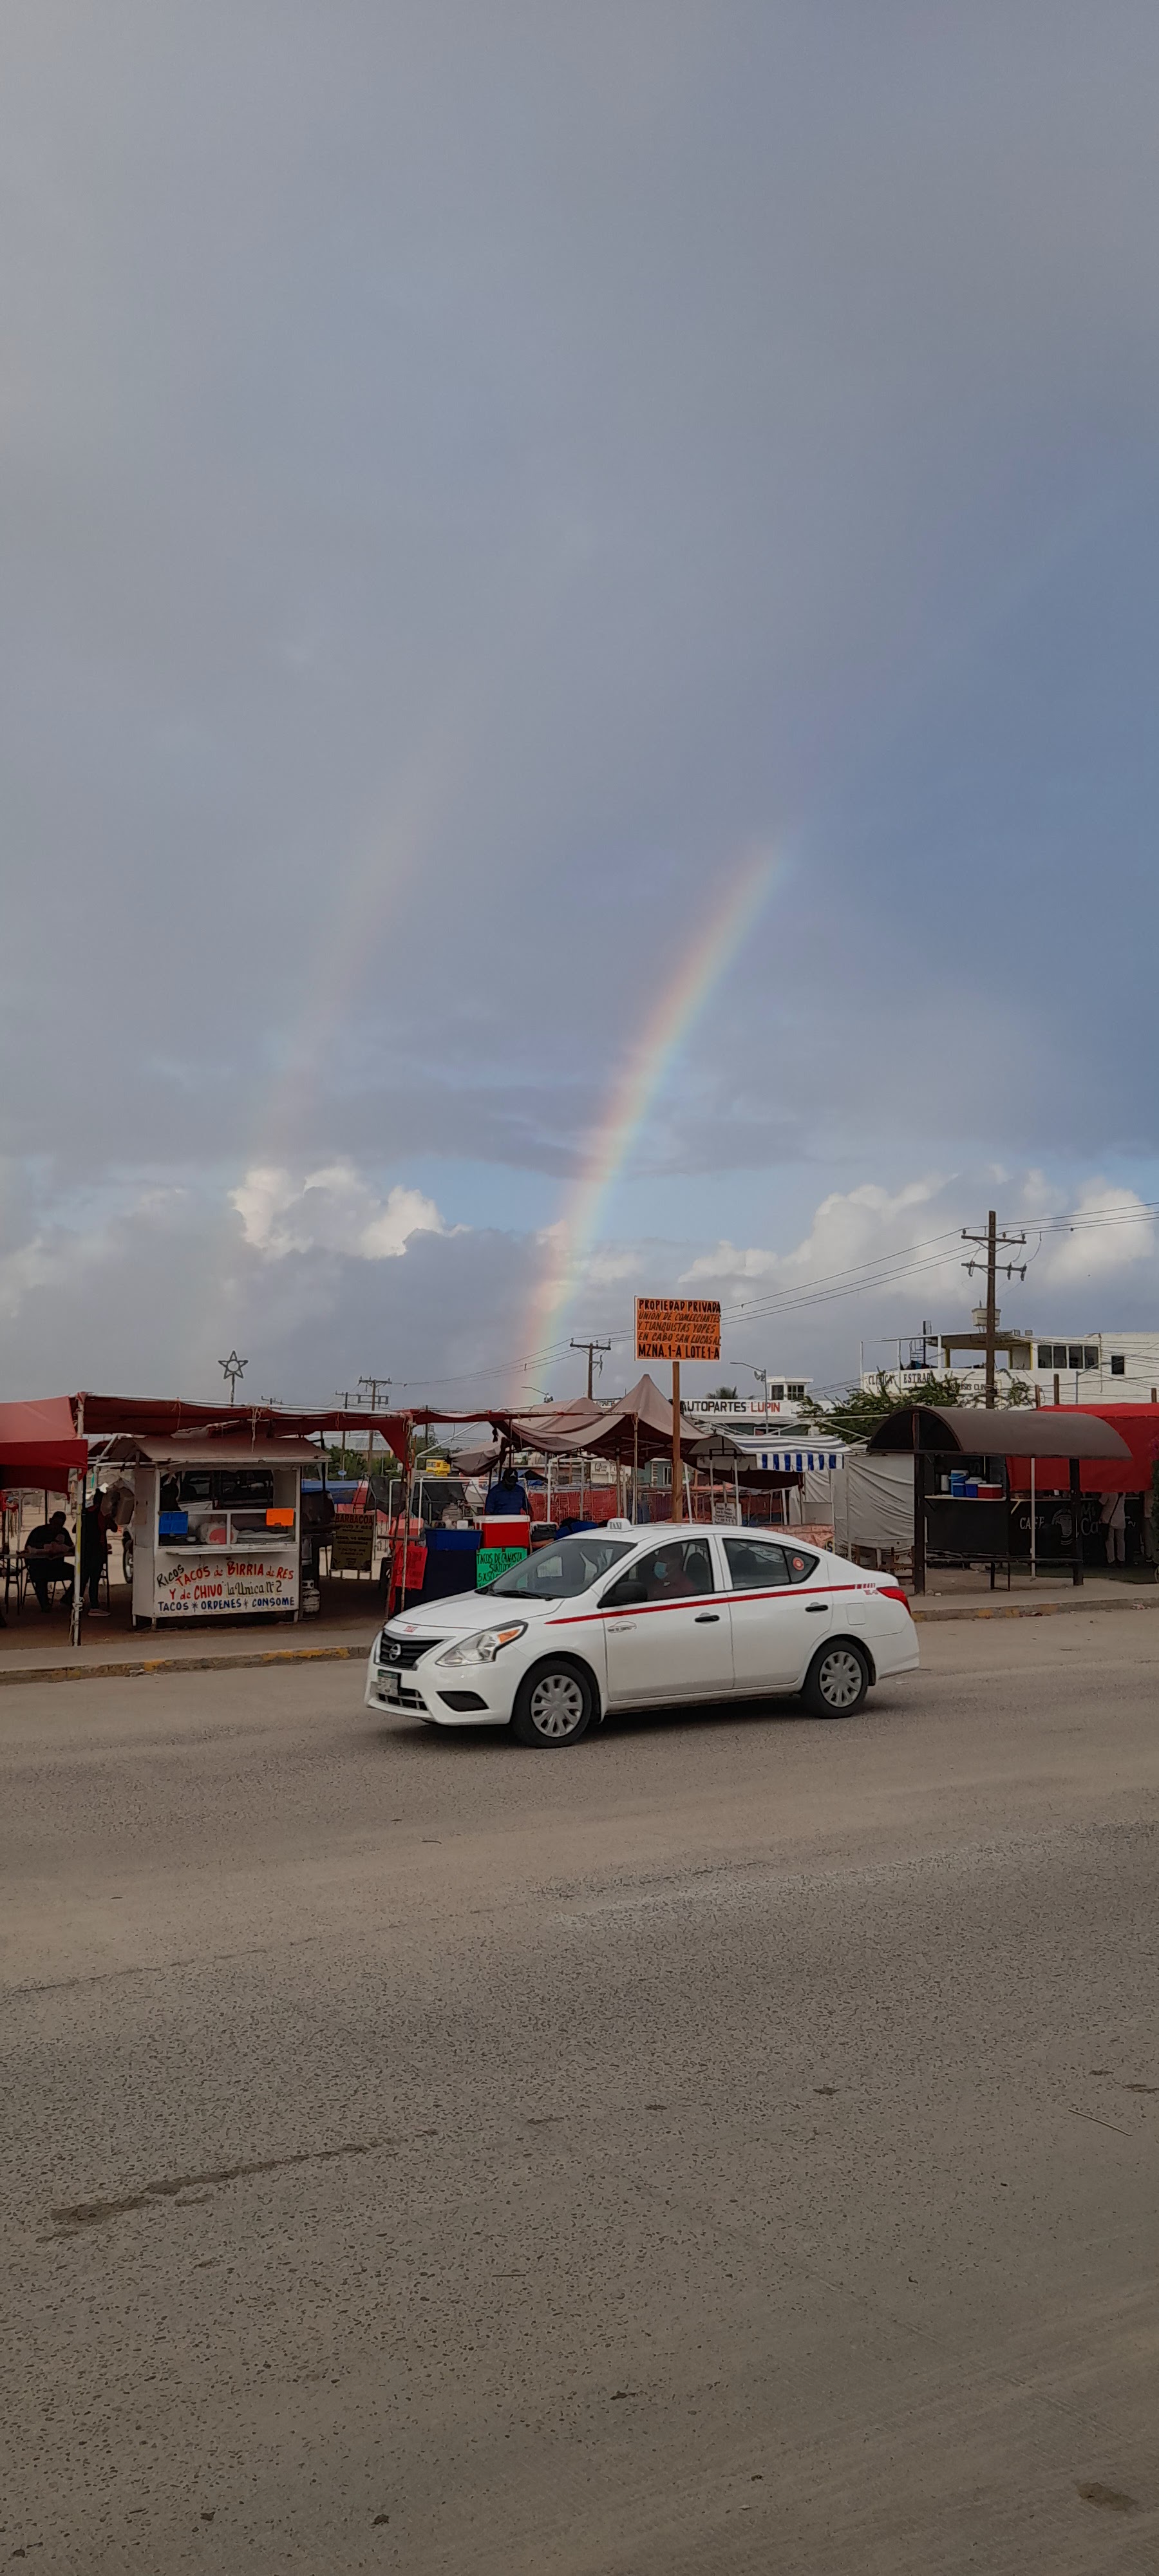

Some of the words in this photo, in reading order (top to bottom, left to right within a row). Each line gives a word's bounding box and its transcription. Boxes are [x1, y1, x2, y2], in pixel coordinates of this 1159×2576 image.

[639, 1300, 686, 1311] PROPIEDAD
[688, 1302, 721, 1313] PRIVADA
[675, 1314, 721, 1323] COMERCIANTES
[638, 1321, 643, 1329] Y
[693, 1323, 717, 1333] YOPES
[639, 1332, 649, 1340] EN
[652, 1332, 673, 1341] CABO
[675, 1334, 690, 1342] SAN
[691, 1334, 713, 1344] LUCAS
[668, 1344, 682, 1358] 1-A
[685, 1345, 706, 1358] LOTE
[707, 1346, 720, 1359] 1-A
[750, 1401, 780, 1412] LUPIN
[335, 1513, 373, 1524] BARBACOA
[477, 1553, 493, 1564] TACOS
[495, 1553, 500, 1564] DE
[156, 1564, 185, 1587] RICOS
[175, 1565, 211, 1587] TACOS
[214, 1565, 223, 1577] de
[227, 1561, 263, 1577] BIRRIA
[276, 1566, 294, 1580] RES
[169, 1587, 177, 1600] Y
[180, 1589, 191, 1600] de
[194, 1583, 223, 1600] CHIVO
[276, 1580, 283, 1593] 2
[158, 1601, 189, 1612] TACOS
[200, 1598, 242, 1610] ORDENES
[252, 1596, 296, 1607] CONSOME
